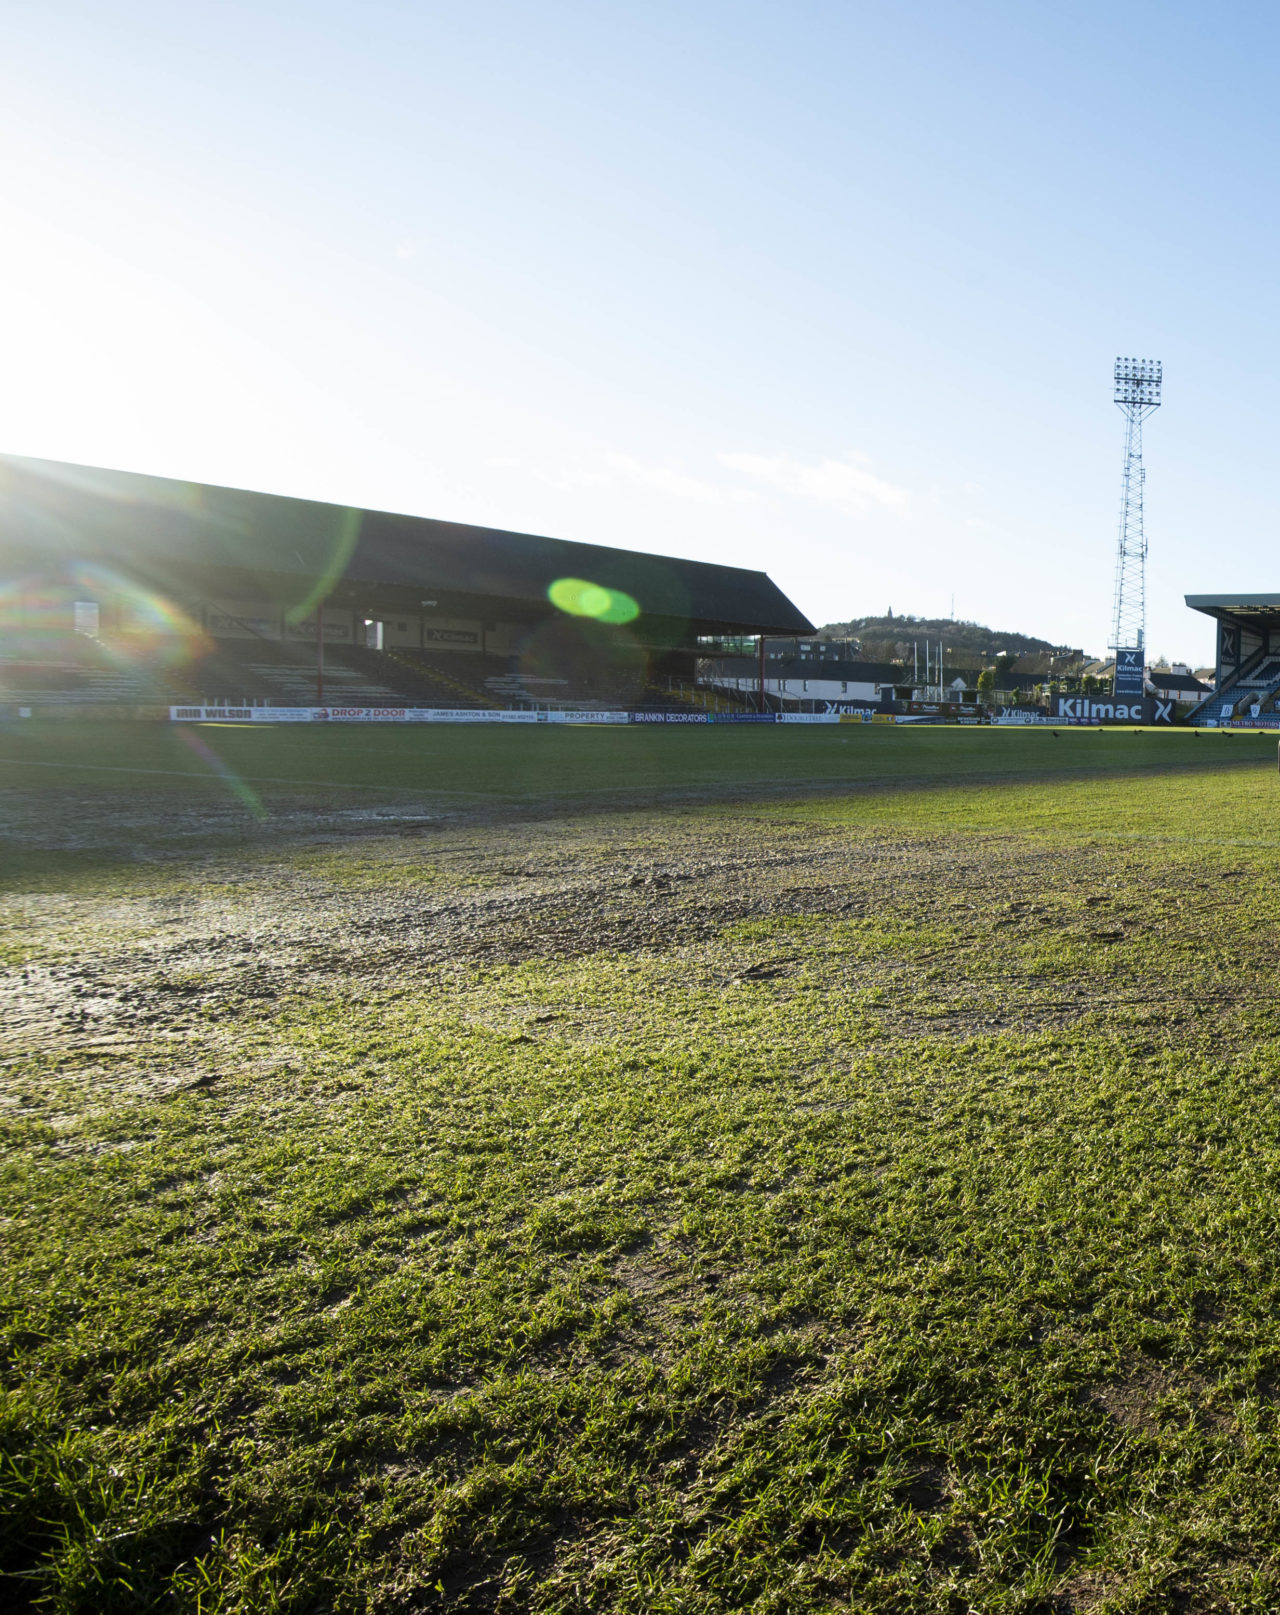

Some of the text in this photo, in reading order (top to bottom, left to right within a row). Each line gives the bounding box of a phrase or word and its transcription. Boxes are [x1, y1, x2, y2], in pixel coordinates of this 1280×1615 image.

[332, 709, 363, 717] DROP
[365, 709, 371, 717] 2
[373, 709, 405, 717] DOOR
[840, 705, 877, 714] Kilmac
[1011, 708, 1040, 717] Kilmac
[1058, 698, 1142, 719] Kilmac
[205, 709, 251, 719] WILSON
[564, 712, 605, 720] PROPERTY
[635, 713, 665, 722] BRANKIN
[666, 713, 707, 722] DECORATORS
